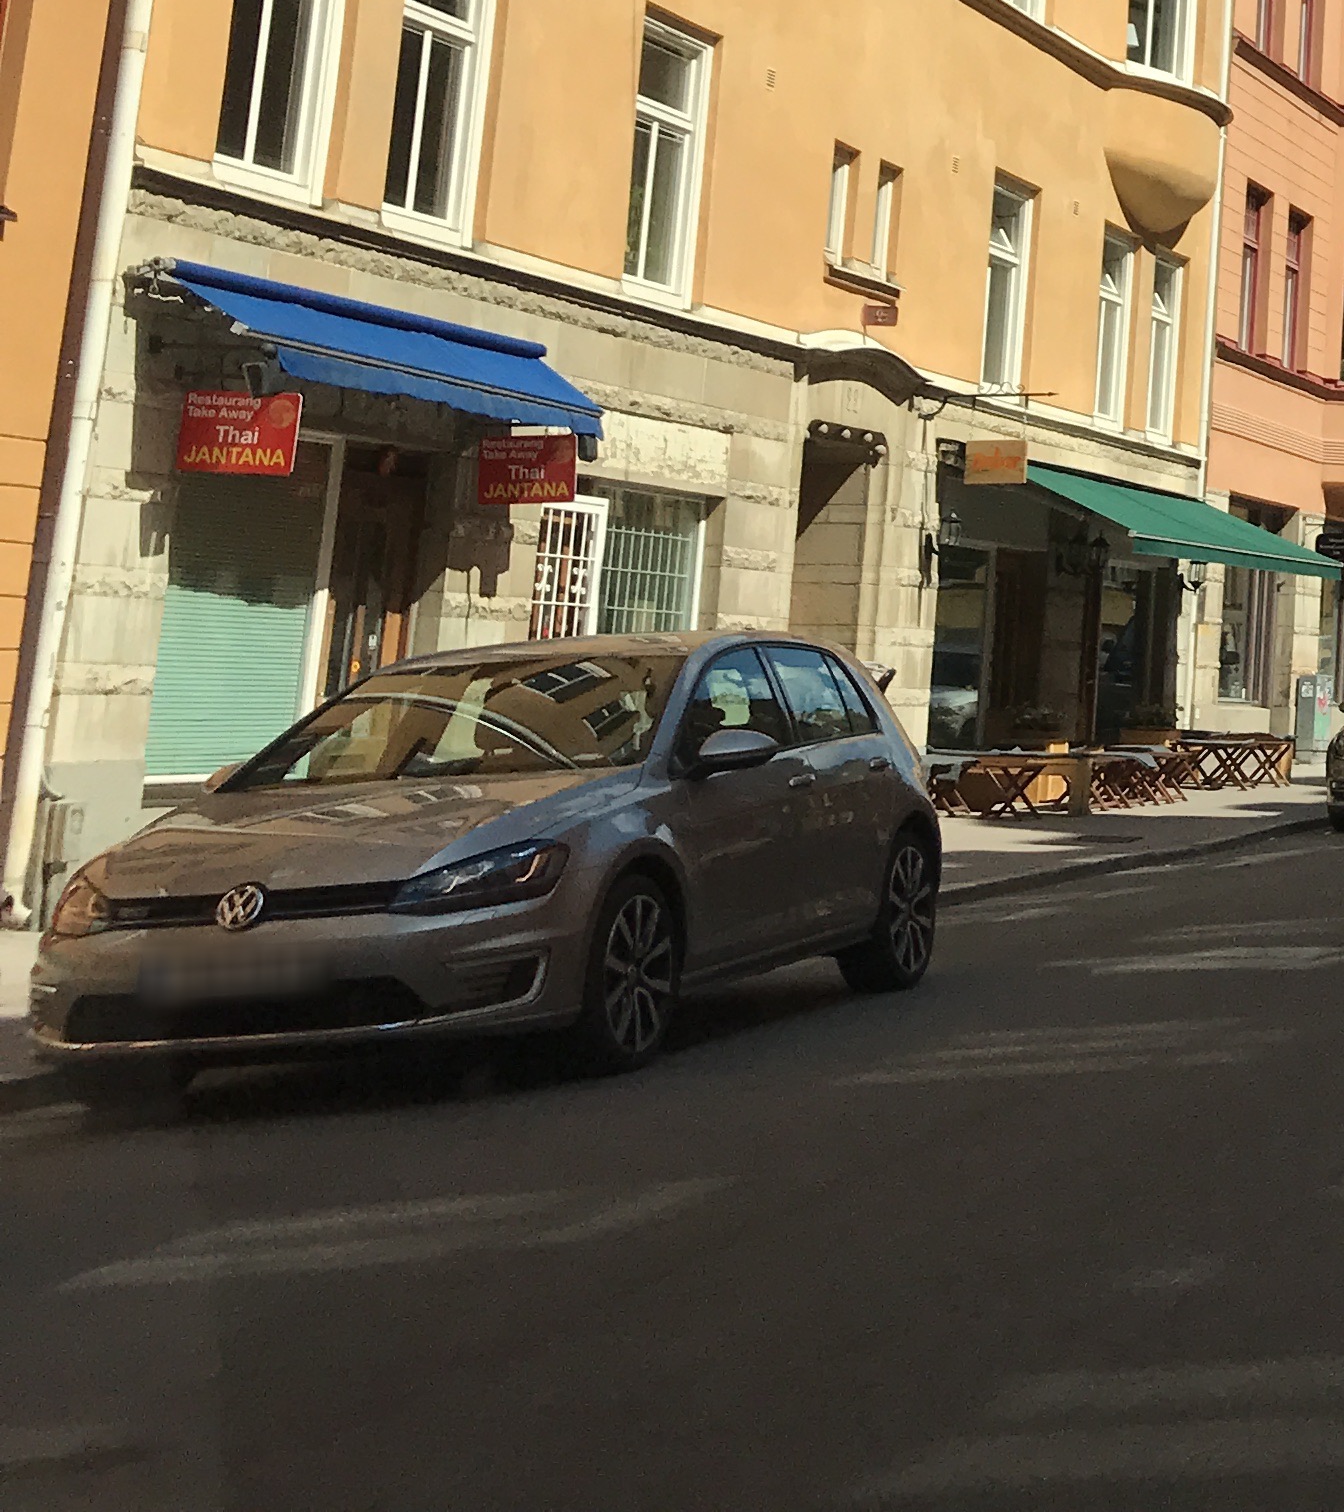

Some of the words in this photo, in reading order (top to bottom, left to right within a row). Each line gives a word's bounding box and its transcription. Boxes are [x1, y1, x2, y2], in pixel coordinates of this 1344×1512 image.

[188, 392, 262, 412] Restaurang
[187, 405, 216, 419] Take
[218, 406, 254, 422] Away
[215, 425, 260, 445] Thai
[183, 445, 286, 467] JANTANA
[508, 464, 545, 480] Thai
[484, 481, 570, 499] JANTANA
